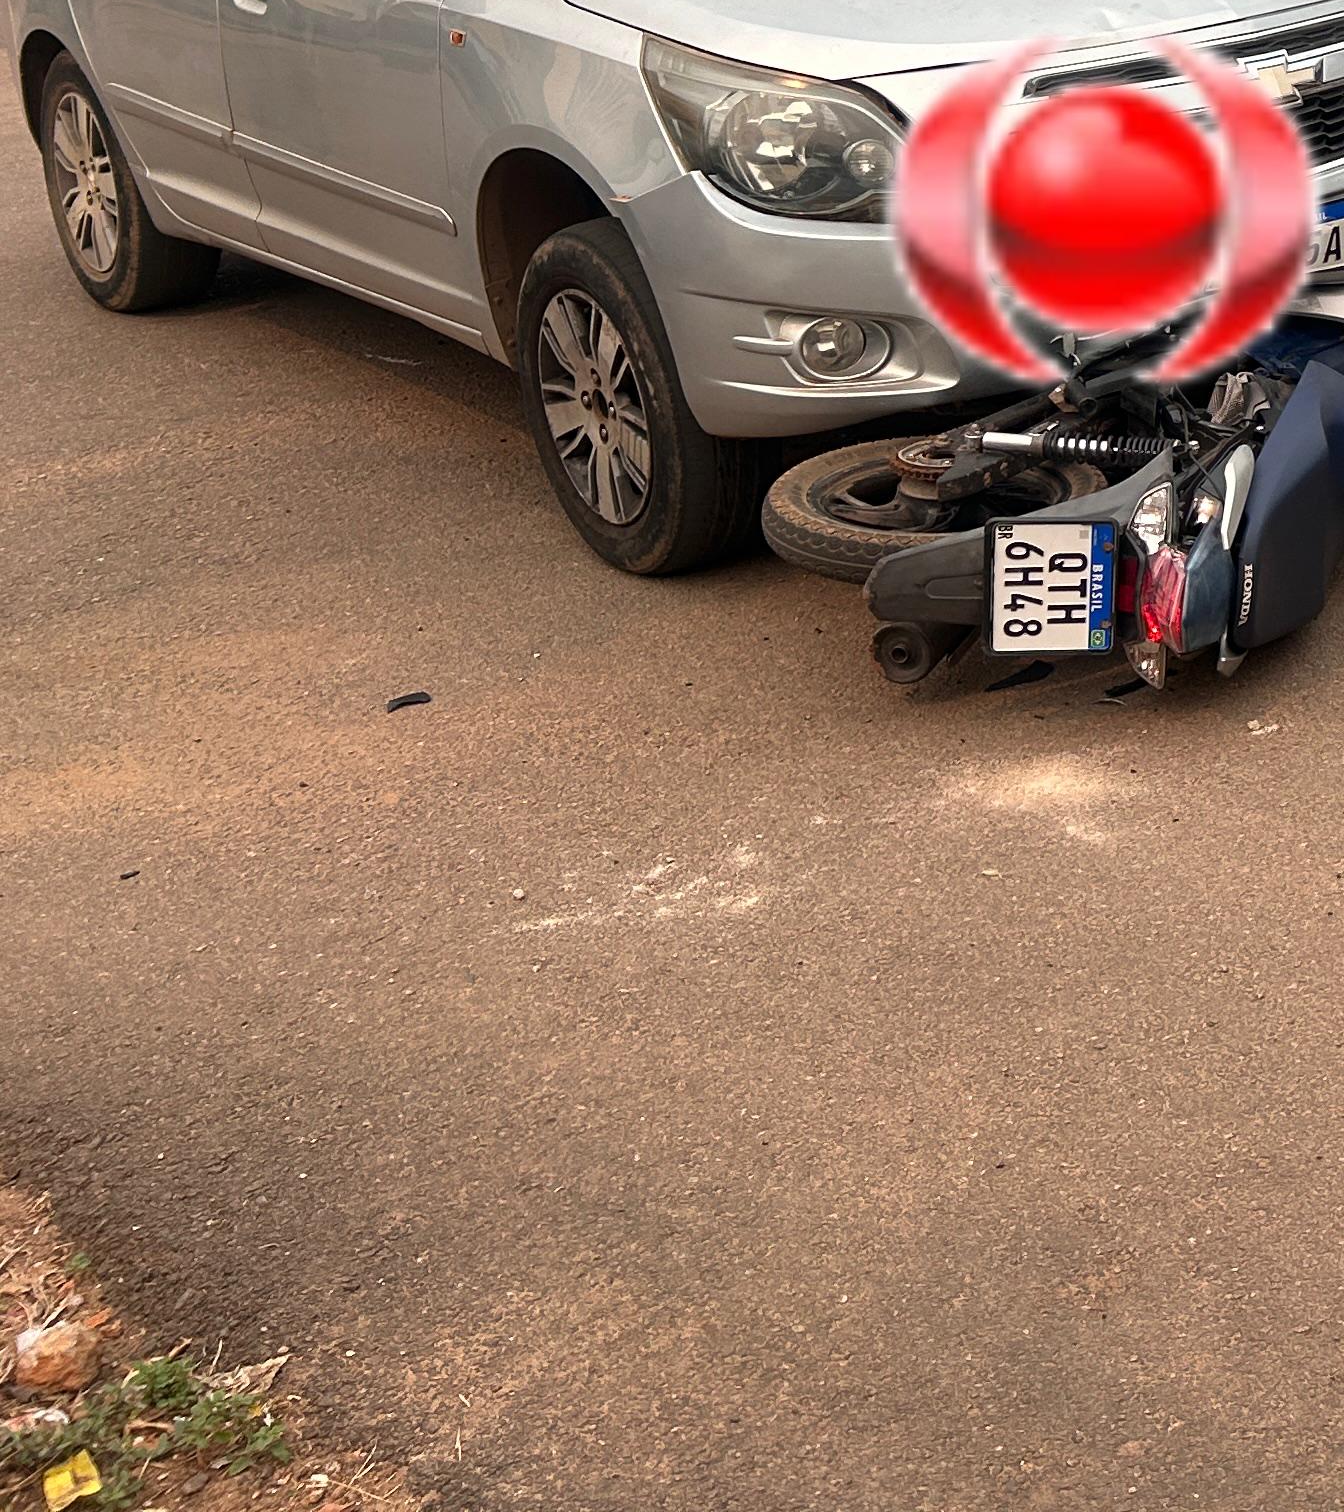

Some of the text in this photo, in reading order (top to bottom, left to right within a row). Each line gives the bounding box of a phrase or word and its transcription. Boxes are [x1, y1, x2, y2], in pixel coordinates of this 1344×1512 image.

[997, 525, 1014, 540] BR
[1003, 540, 1044, 638] 6H48
[1047, 551, 1088, 625] QTH
[1090, 563, 1104, 612] BRASIL
[1238, 563, 1253, 626] HONDA
